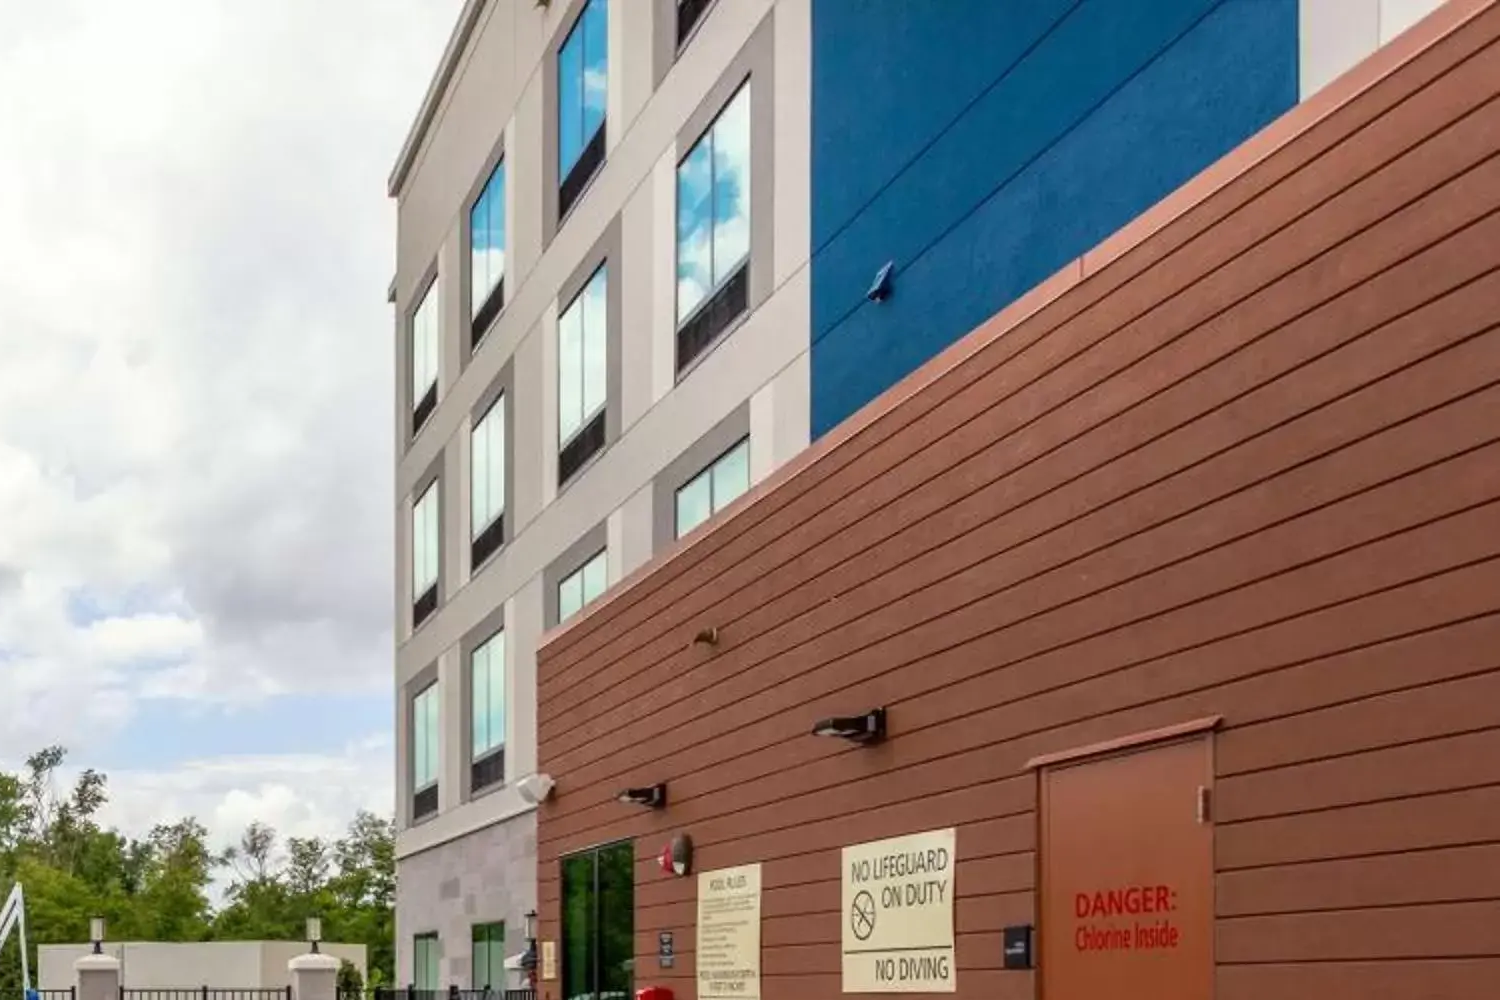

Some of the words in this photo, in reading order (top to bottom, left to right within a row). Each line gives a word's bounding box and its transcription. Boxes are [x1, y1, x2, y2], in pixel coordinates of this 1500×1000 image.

[851, 861, 870, 882] NO
[873, 848, 948, 880] LIFEGUARD
[881, 885, 901, 909] ON
[906, 879, 947, 906] DUTY
[1076, 885, 1177, 918] DANGER:
[1075, 925, 1131, 951] Chlorine
[1134, 920, 1178, 950] Inside
[875, 959, 895, 981] NO
[899, 956, 949, 980] DIVING
